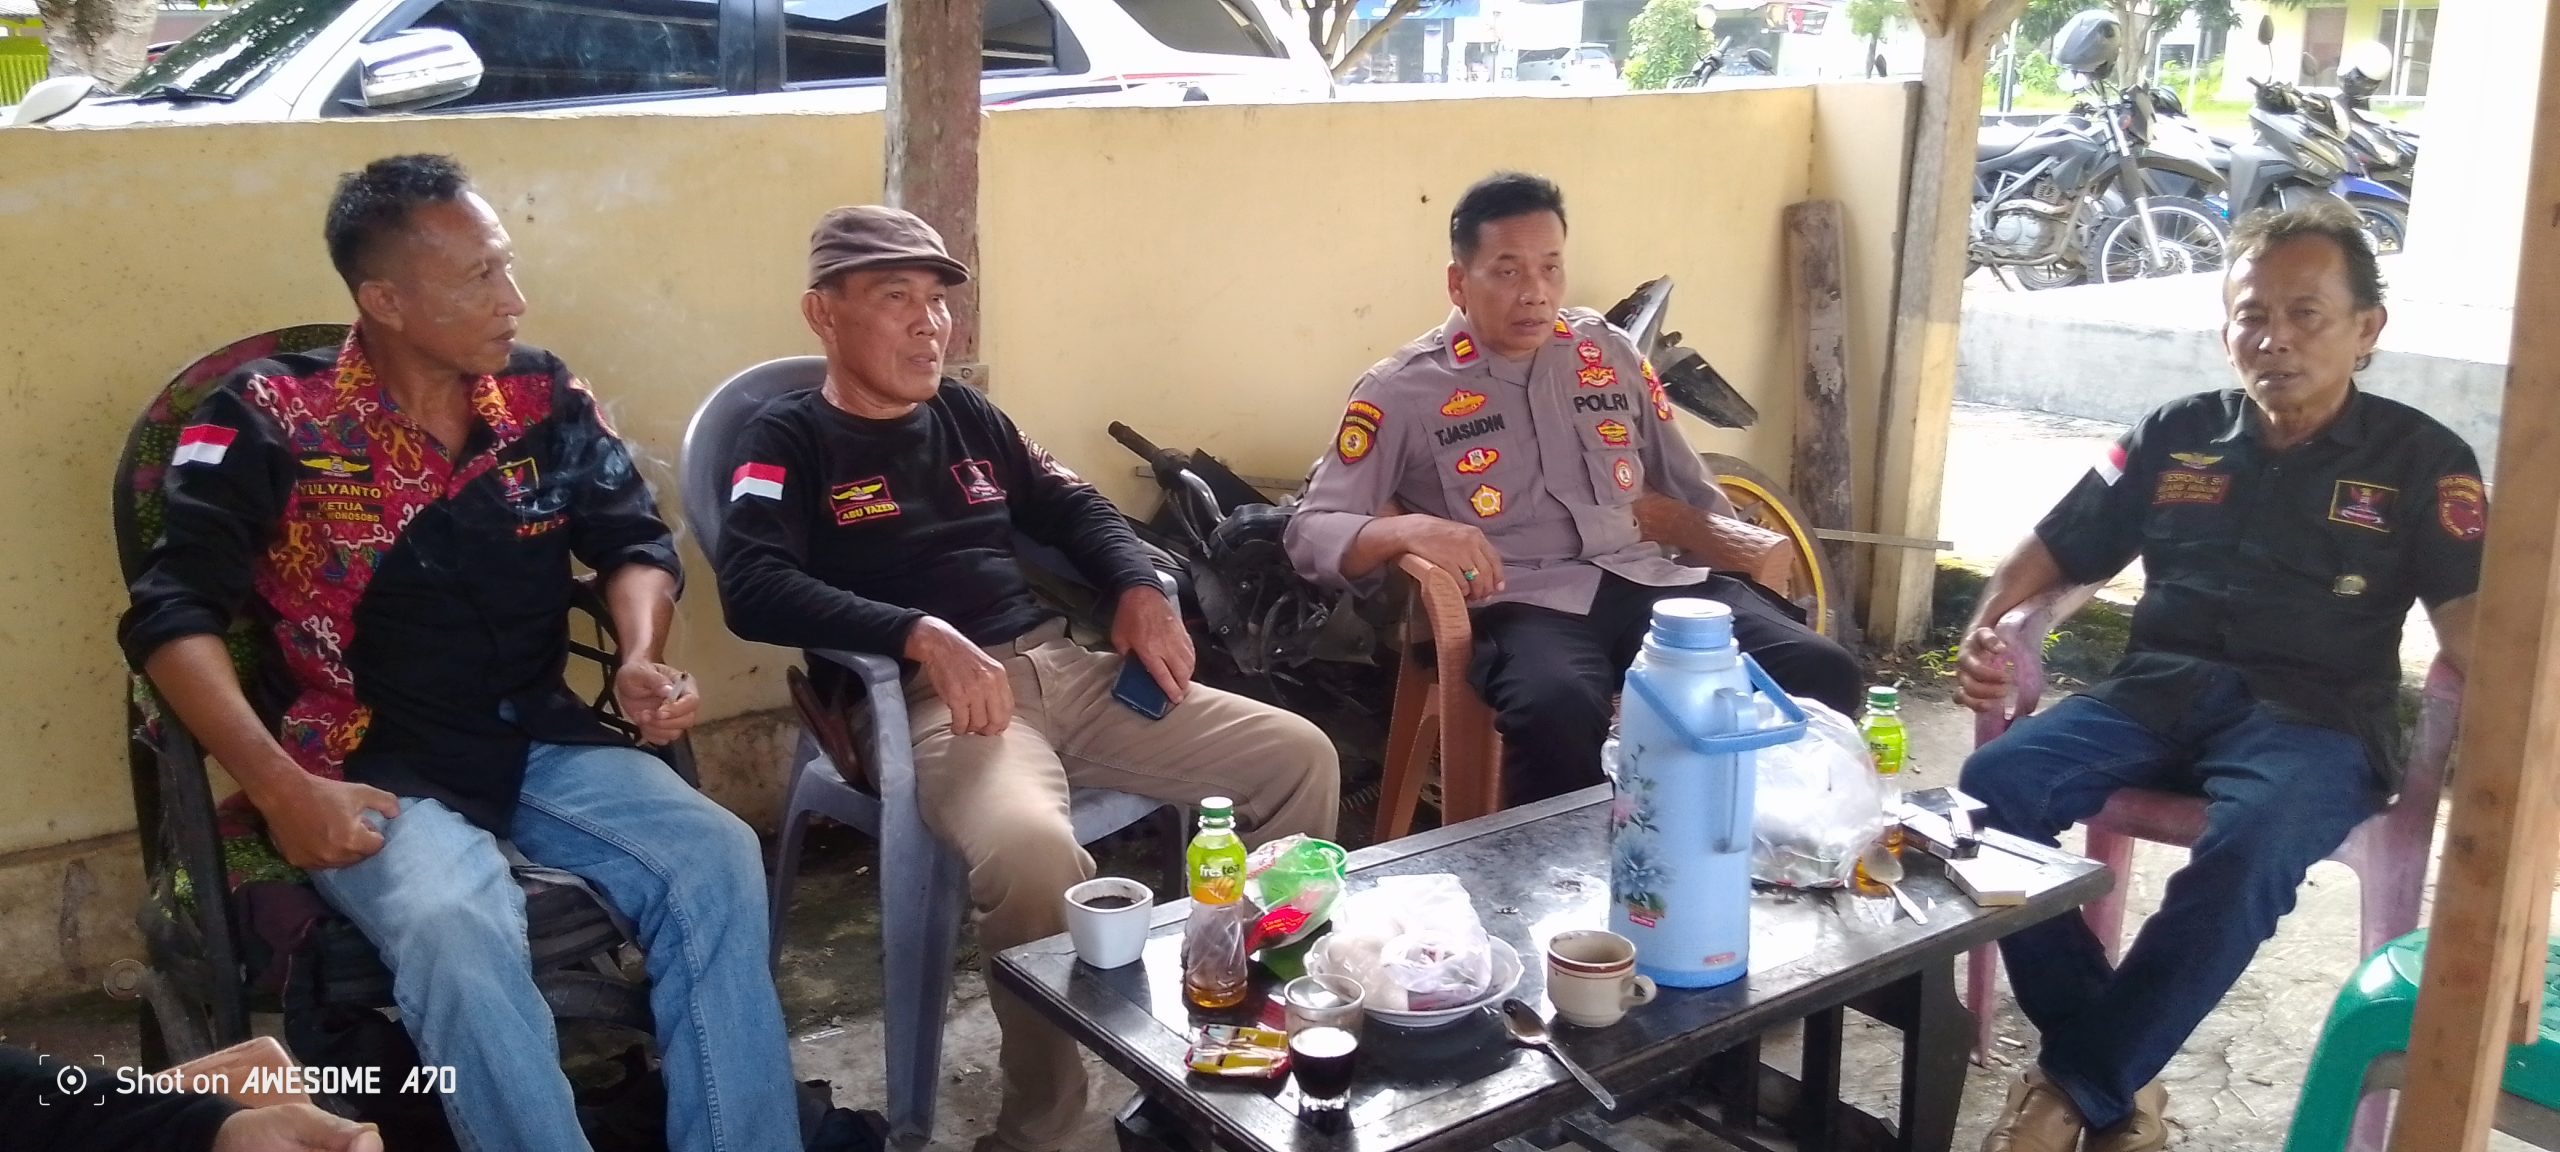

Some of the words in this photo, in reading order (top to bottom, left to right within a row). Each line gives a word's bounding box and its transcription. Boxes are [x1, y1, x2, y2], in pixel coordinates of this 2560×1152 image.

[1574, 393, 1629, 413] POLRI
[1434, 413, 1505, 446] TJASUDIN
[300, 483, 382, 499] YULYANTO
[319, 501, 363, 511] KETUA
[842, 507, 864, 520] ABU
